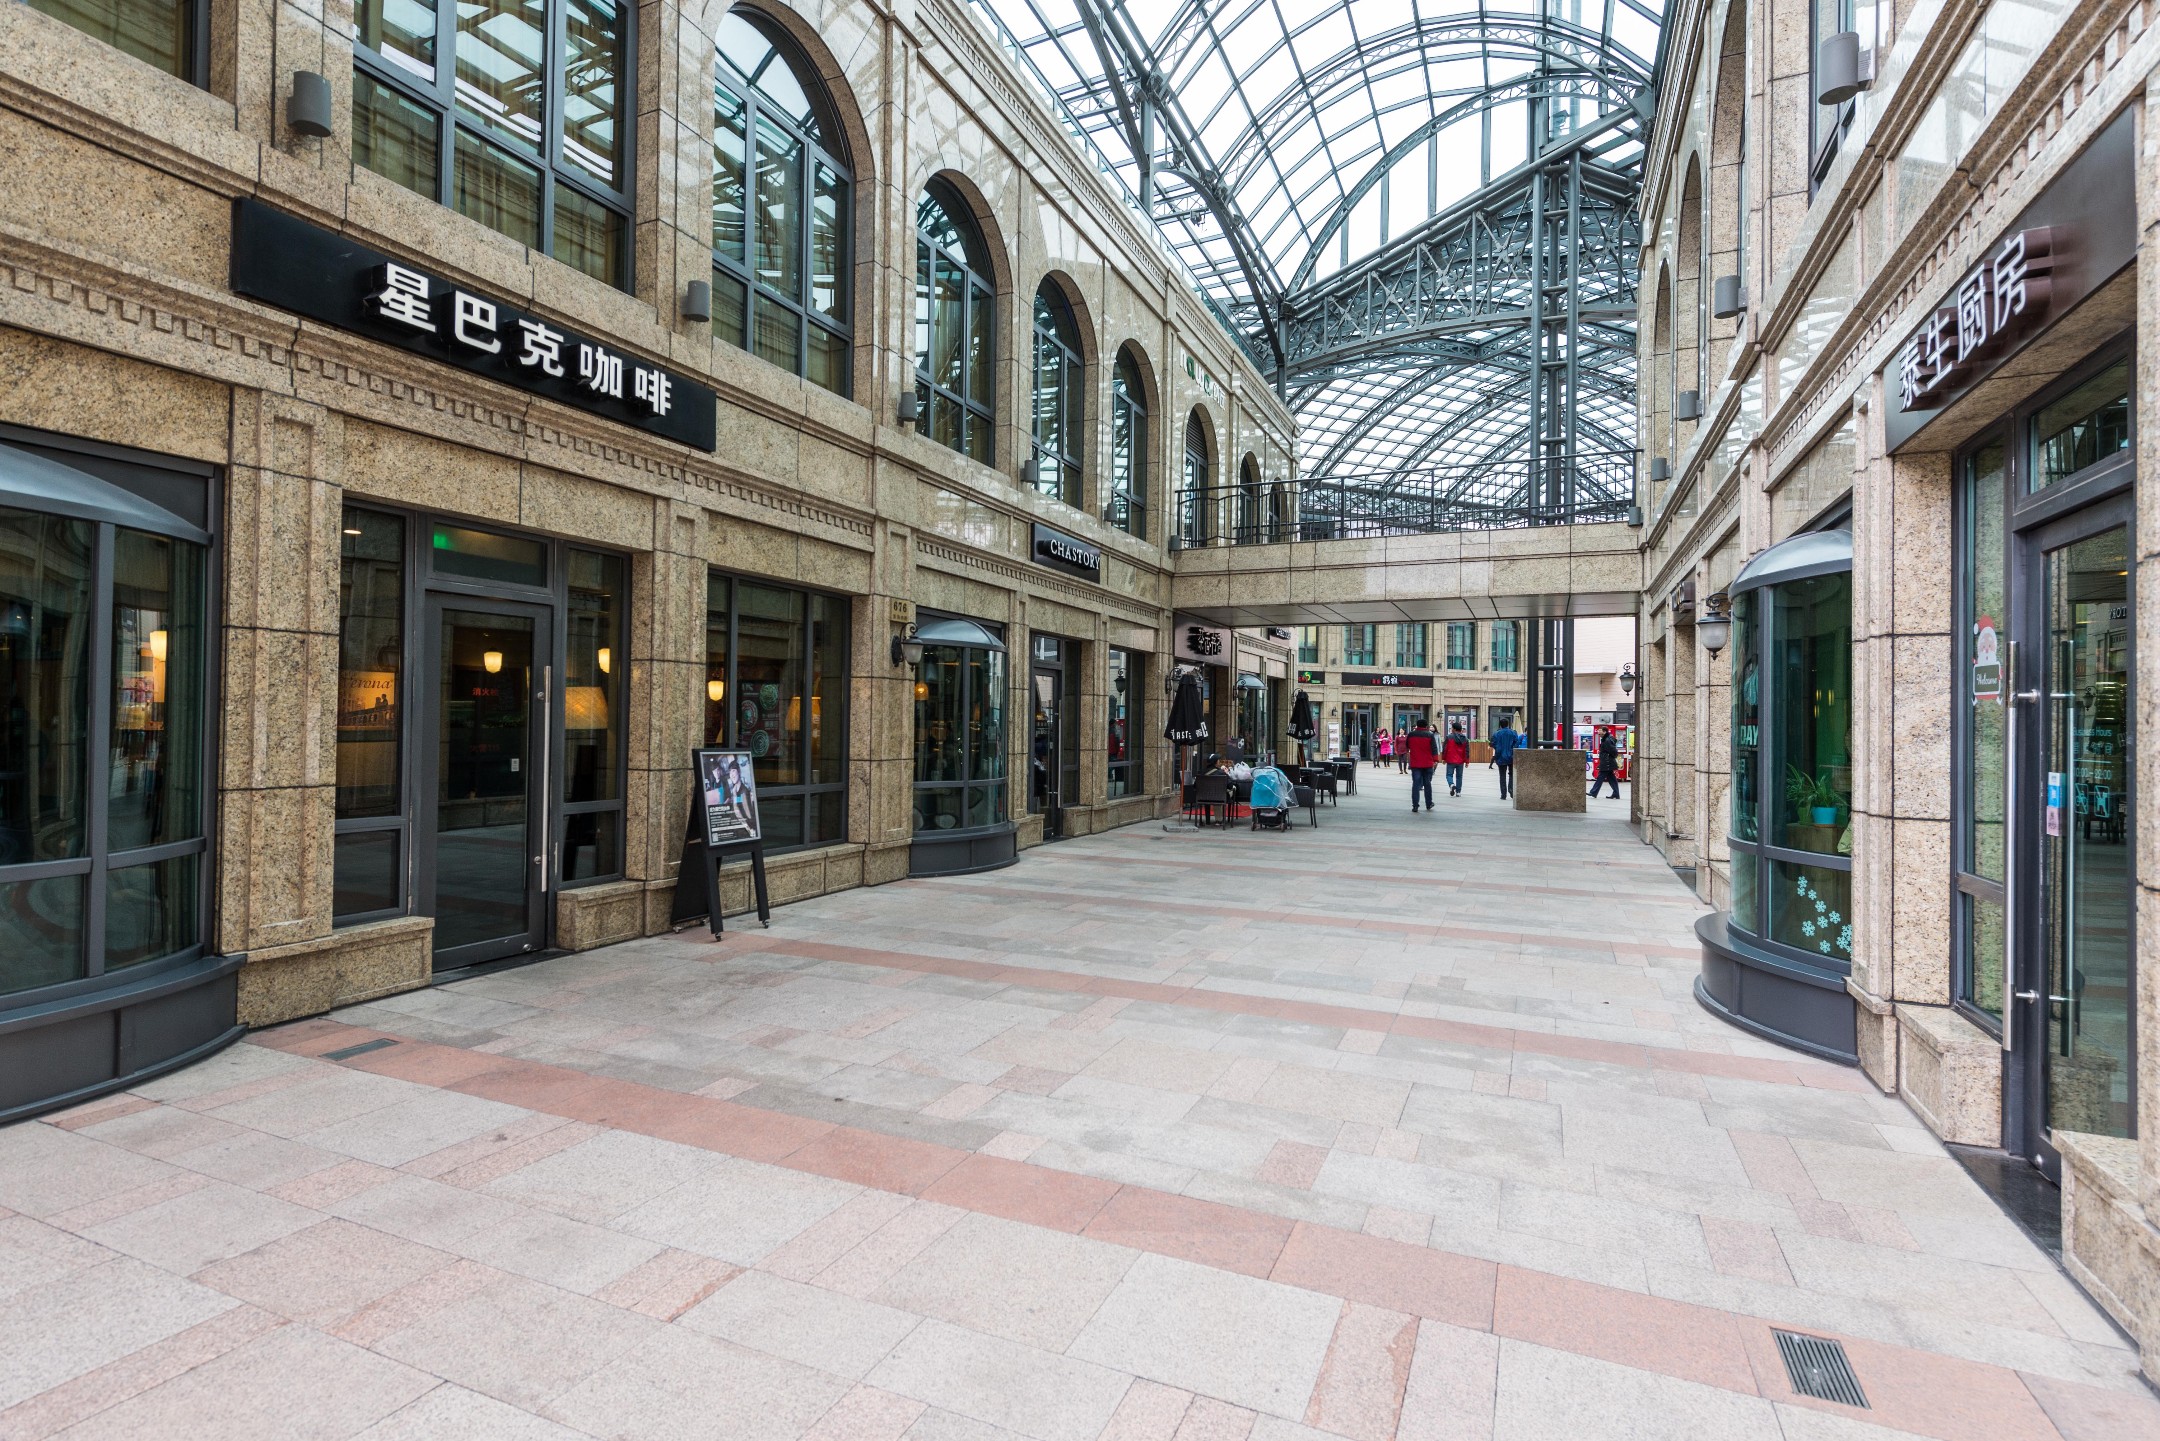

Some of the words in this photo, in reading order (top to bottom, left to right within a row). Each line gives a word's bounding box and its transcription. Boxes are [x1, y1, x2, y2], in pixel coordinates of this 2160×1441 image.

[1898, 231, 2028, 413] 泰生厨房
[378, 262, 672, 416] 星巴克咖啡
[1050, 539, 1101, 569] CHASTORY
[893, 601, 907, 613] 676
[1740, 725, 1759, 746] DAY
